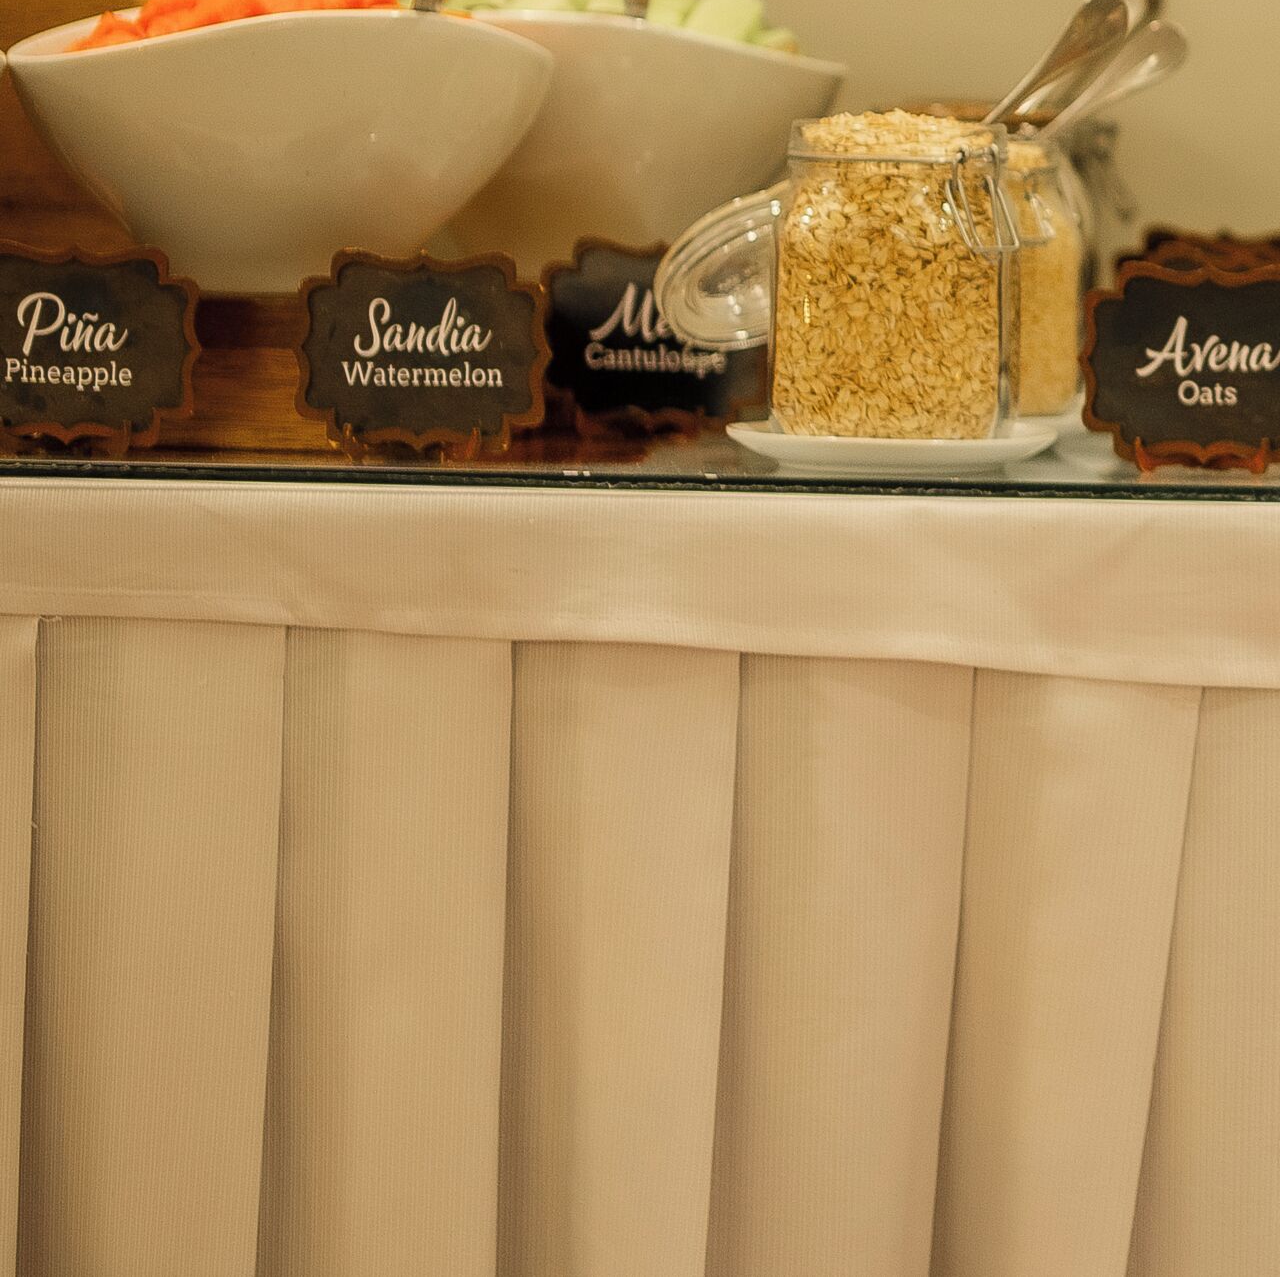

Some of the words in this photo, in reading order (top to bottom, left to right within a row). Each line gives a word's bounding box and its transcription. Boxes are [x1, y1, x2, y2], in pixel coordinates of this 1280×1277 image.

[16, 291, 129, 356] Piña
[353, 297, 494, 358] Sandia
[4, 357, 134, 392] Pineapple
[341, 360, 503, 387] Watermelon
[1177, 379, 1239, 406] Oats
